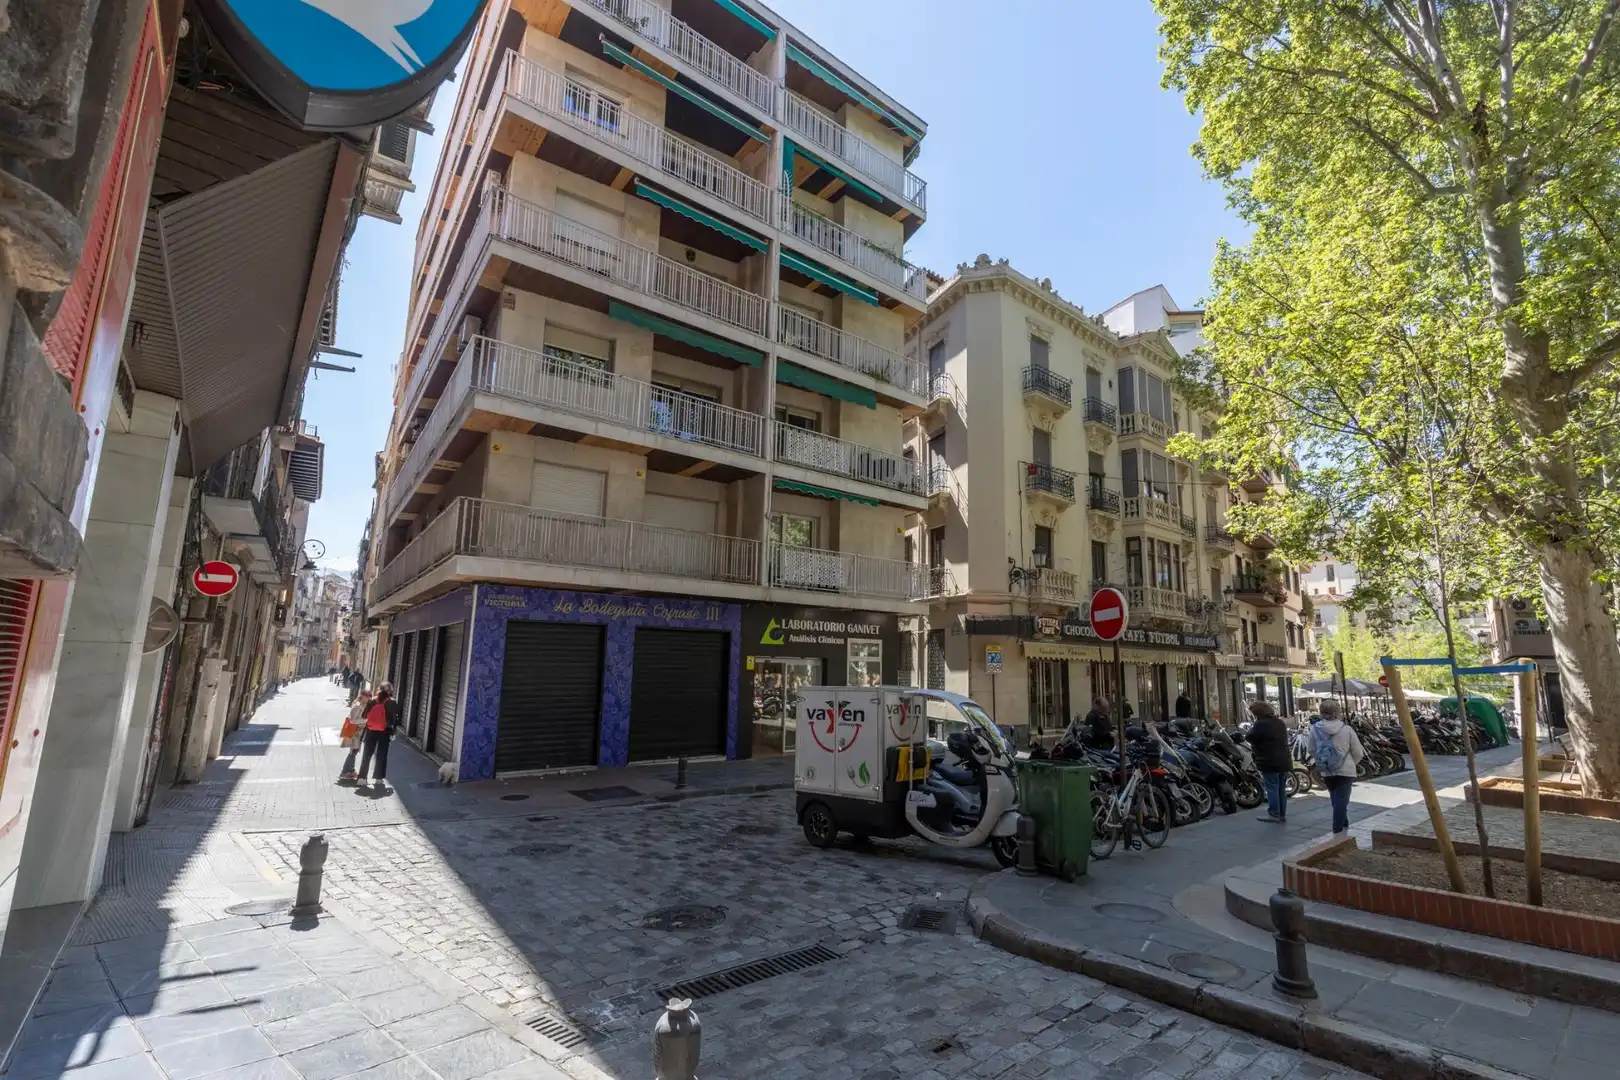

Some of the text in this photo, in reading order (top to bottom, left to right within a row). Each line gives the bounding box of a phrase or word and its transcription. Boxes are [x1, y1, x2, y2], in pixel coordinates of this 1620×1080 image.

[484, 599, 526, 608] VICTORIA
[553, 596, 574, 614] La
[579, 598, 648, 620] Bodeguita
[653, 603, 701, 622] Cofrade
[781, 619, 880, 635] LABORATORIO GANIVET
[1065, 624, 1097, 637] CHOCOL
